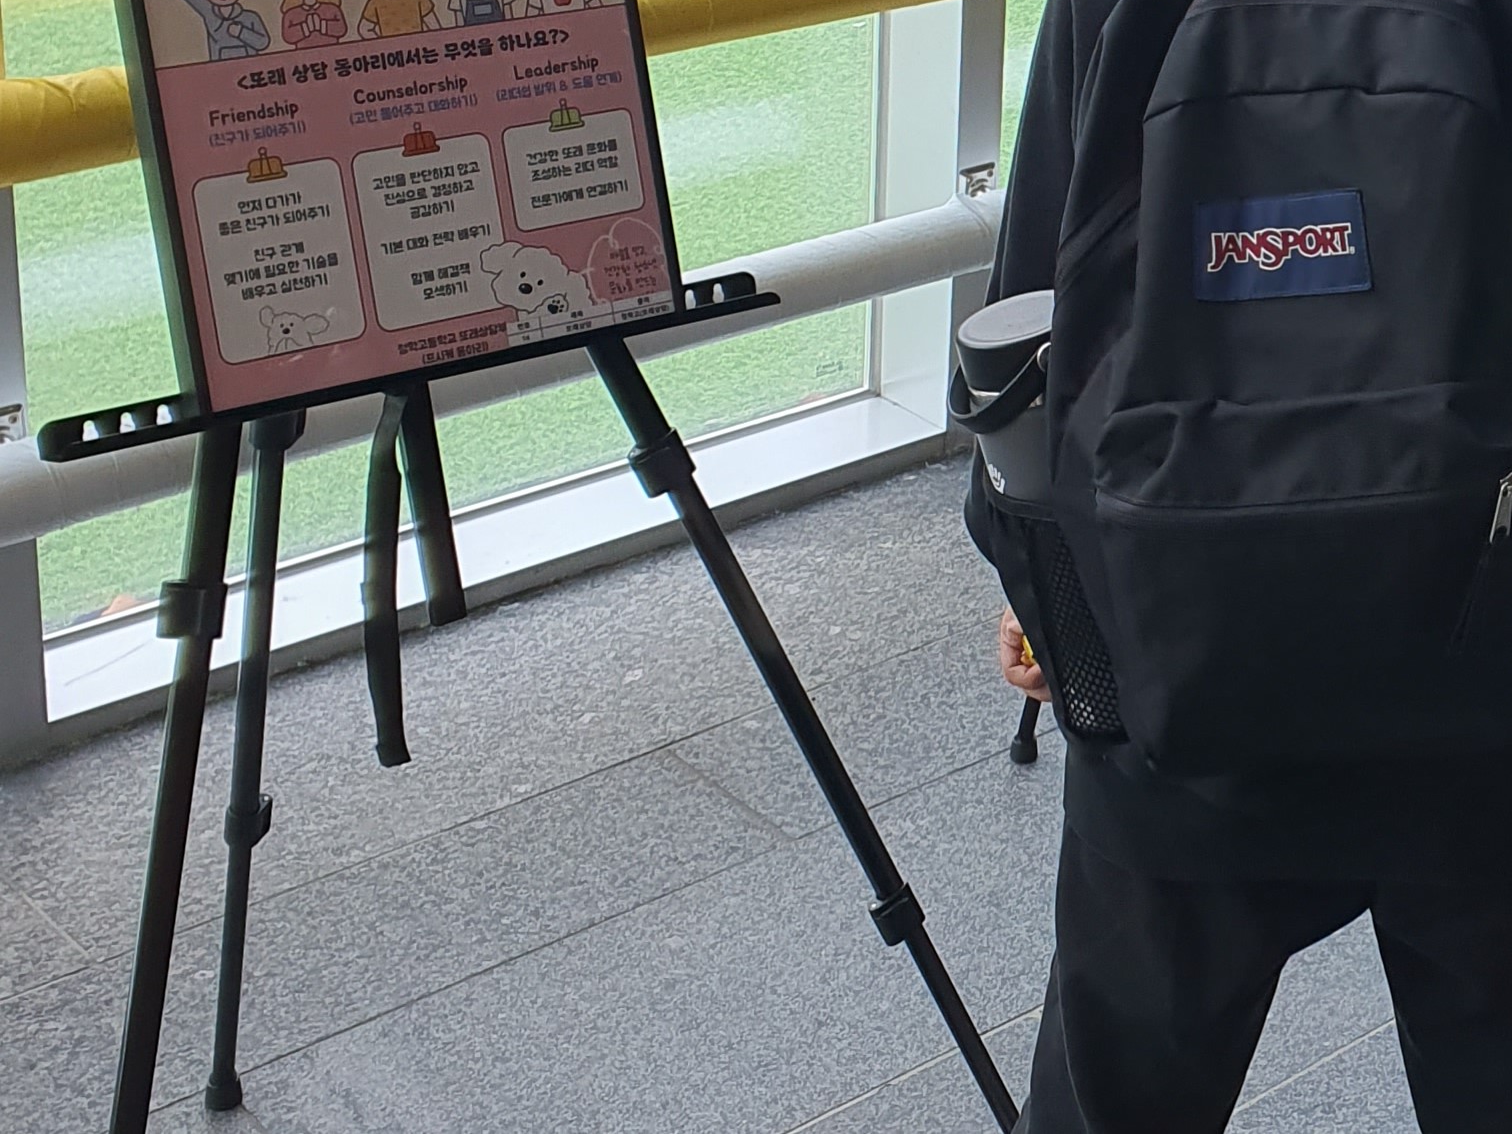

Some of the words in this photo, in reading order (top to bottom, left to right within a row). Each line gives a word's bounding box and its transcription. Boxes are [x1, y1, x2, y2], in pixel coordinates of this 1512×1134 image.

[237, 67, 286, 90] <또래
[292, 61, 328, 83] 상담
[334, 47, 438, 78] 동아리에서는
[443, 37, 494, 60] 무엇을
[498, 28, 570, 52] 하나요?>
[513, 55, 599, 81] Leadership
[353, 75, 468, 105] Counselorship
[572, 76, 594, 90] 도움
[596, 71, 622, 85] 연계)
[209, 99, 299, 127] Friendship
[350, 108, 378, 126] (고민
[428, 93, 478, 113] 대화하기)
[209, 129, 249, 147] (친구가
[253, 120, 306, 140] 되어주기)
[526, 149, 559, 166] 건강한
[562, 145, 584, 159] 또래
[585, 138, 618, 156] 문화를
[372, 173, 406, 190] 고민을
[409, 165, 455, 184] 판단하지
[456, 161, 480, 176] 않고
[531, 164, 572, 182] 조성하는
[574, 160, 595, 174] 리더
[597, 155, 619, 169] 역할
[237, 199, 263, 214] 먼저
[265, 191, 302, 209] 다가가
[383, 187, 428, 207] 진심으로
[430, 179, 475, 198] 경청하고
[530, 187, 584, 209] 전문가에게
[586, 178, 629, 198] 연결하기
[218, 220, 243, 236] 좋은
[245, 213, 280, 232] 친구가
[283, 204, 330, 224] 되어주기
[409, 200, 455, 219] 공감하기
[254, 246, 277, 262] 친구
[280, 241, 305, 257] 관계
[380, 240, 404, 255] 기본
[406, 235, 429, 251] 대화
[432, 230, 455, 246] 전략
[457, 223, 491, 240] 배우기
[1207, 222, 1352, 272] JANSPORT
[223, 268, 261, 286] 맺기에
[264, 260, 300, 279] 필요한
[302, 252, 339, 270] 기술을
[410, 270, 435, 286] 함께
[437, 262, 471, 280] 해결책
[241, 283, 278, 301] 배우고
[280, 273, 328, 293] 실천하기
[423, 280, 469, 300] 모색하기
[457, 341, 489, 358] 동아리)
